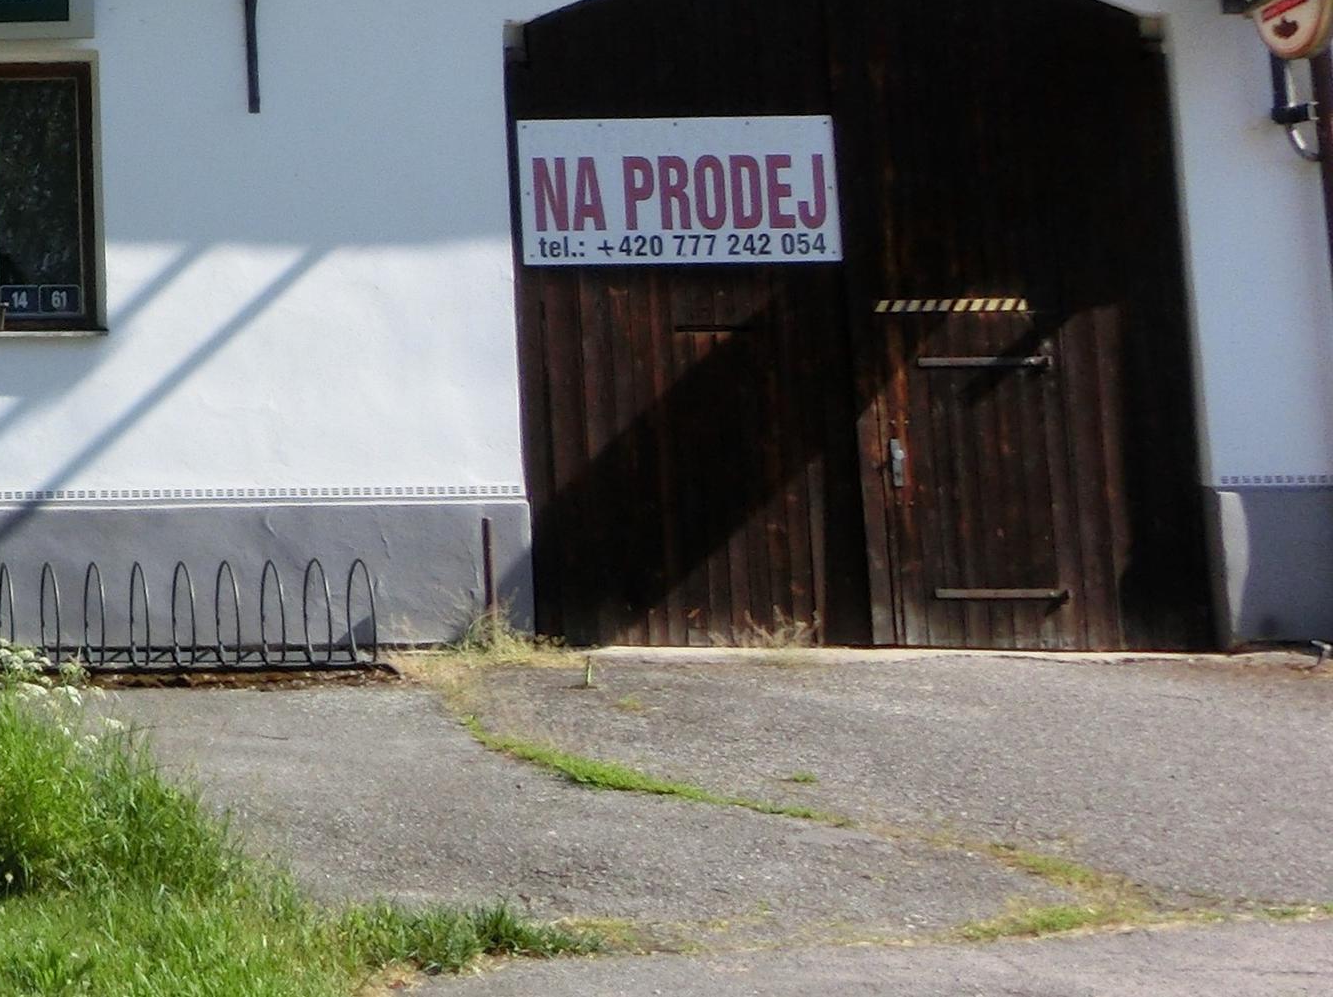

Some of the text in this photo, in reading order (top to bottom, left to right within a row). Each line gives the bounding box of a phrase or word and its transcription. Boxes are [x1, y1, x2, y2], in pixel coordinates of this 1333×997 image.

[532, 153, 829, 232] NA PRODEJ
[538, 232, 827, 259] tel.: +420 777 242 054
[11, 290, 28, 309] 14
[51, 290, 67, 309] 61
